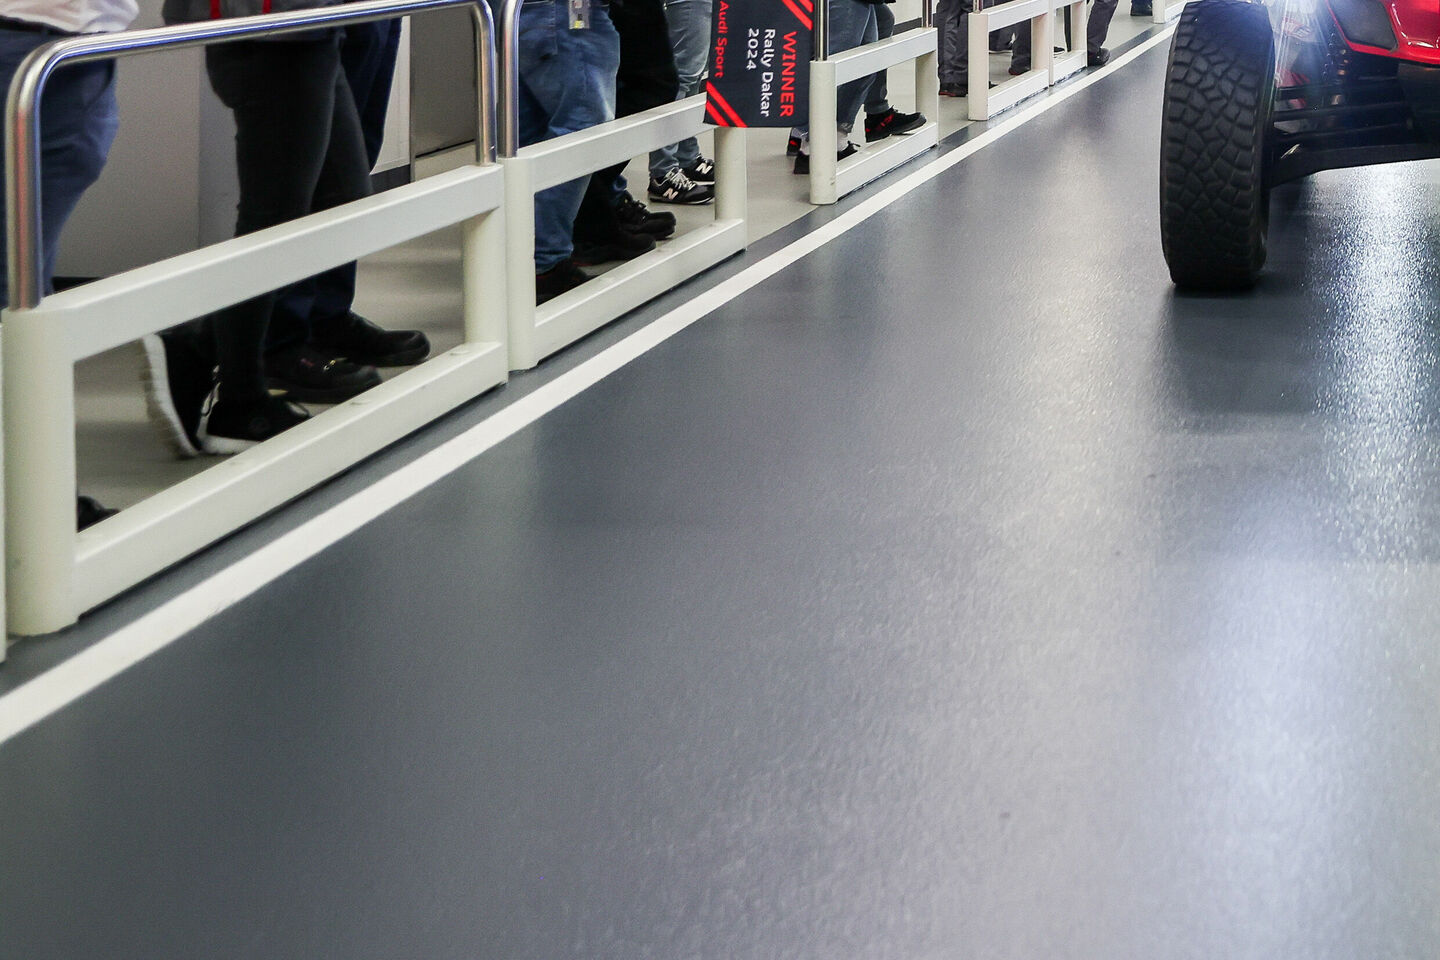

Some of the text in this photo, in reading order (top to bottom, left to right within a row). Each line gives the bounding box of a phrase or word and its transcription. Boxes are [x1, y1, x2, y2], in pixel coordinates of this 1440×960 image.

[714, 0, 729, 78] Audi Sport
[746, 27, 759, 71] 2024
[760, 28, 776, 117] Rally Dakar
[779, 31, 798, 117] WINNER
